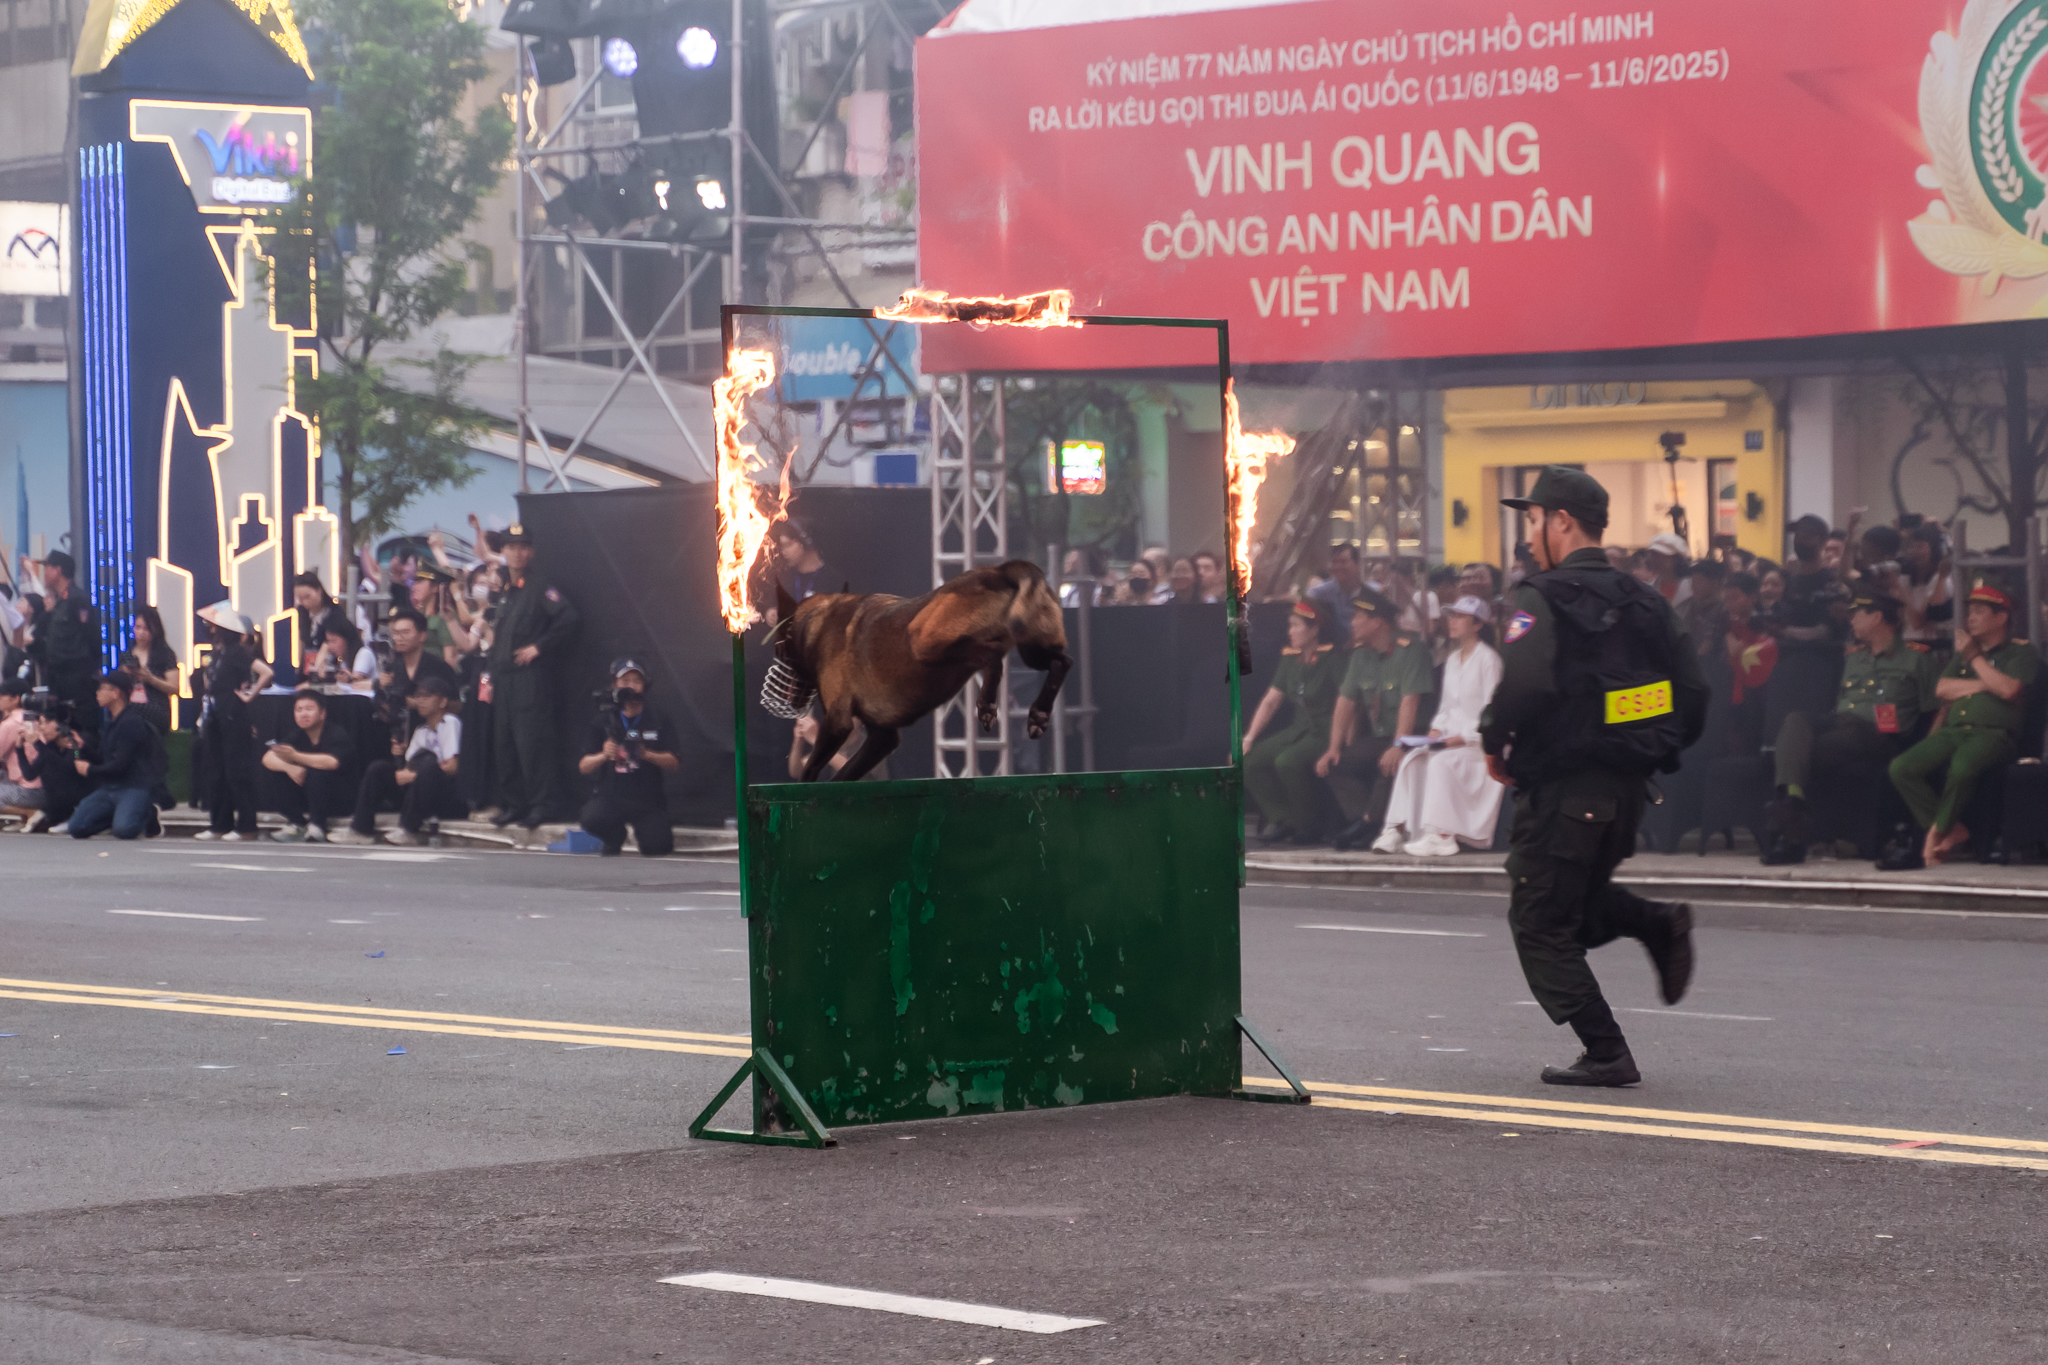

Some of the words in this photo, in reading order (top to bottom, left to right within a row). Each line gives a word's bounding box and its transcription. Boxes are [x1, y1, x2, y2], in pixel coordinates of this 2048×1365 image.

[1118, 52, 1181, 90] NIỆM
[1184, 53, 1213, 79] 77
[1216, 44, 1273, 78] NĂM
[1277, 36, 1349, 73] NGÀY
[1352, 28, 1409, 66] CHỦ
[1412, 27, 1476, 65] TỊCH
[1481, 12, 1523, 54] HỒ
[1527, 12, 1577, 50] CHÍ
[1581, 10, 1655, 44] MINH
[1028, 106, 1062, 132] RA
[1065, 99, 1103, 130] LỜI
[1106, 96, 1156, 128] KÊU
[1160, 96, 1205, 128] GỌI
[1208, 93, 1250, 120] THI
[1254, 88, 1308, 118] ĐUA
[1310, 79, 1338, 114] ÁI
[1341, 68, 1421, 115] QUỐC
[1424, 64, 1561, 107] (11/6/1948
[1588, 47, 1730, 90] 11/6/2025)
[1185, 140, 1313, 198] VINH
[1331, 121, 1540, 191] QUANG
[1141, 208, 1269, 263] CÔNG
[1277, 212, 1339, 255] AN
[1348, 194, 1482, 251] NHÂN
[1491, 187, 1594, 244] DÂN
[1249, 264, 1347, 328] VIỆT
[1362, 266, 1470, 315] NAM
